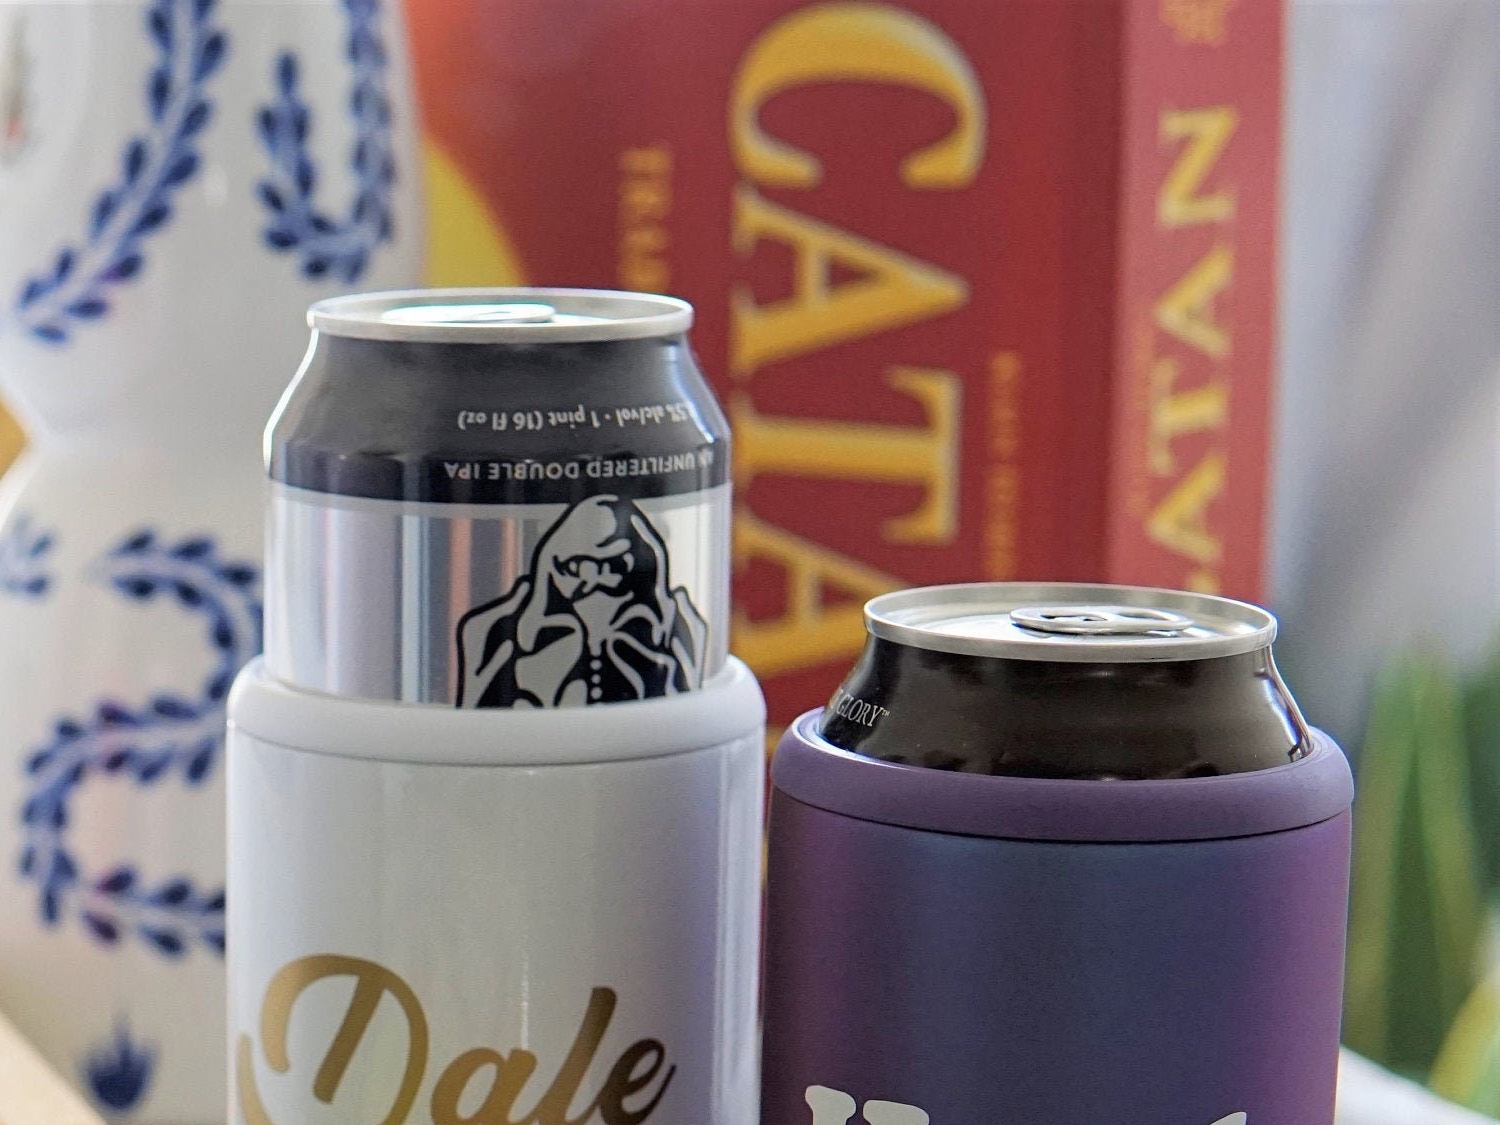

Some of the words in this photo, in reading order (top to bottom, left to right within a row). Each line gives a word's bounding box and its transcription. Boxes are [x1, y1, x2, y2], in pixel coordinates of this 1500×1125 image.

[730, 3, 987, 690] CATA
[1145, 108, 1238, 593] ATAN
[457, 410, 488, 431] oz)
[492, 411, 508, 431] fl
[513, 410, 544, 431] (16
[548, 404, 586, 429] pint
[444, 461, 481, 480] IPA
[488, 461, 580, 480] DOUBLE
[585, 452, 696, 479] UNFILTERED
